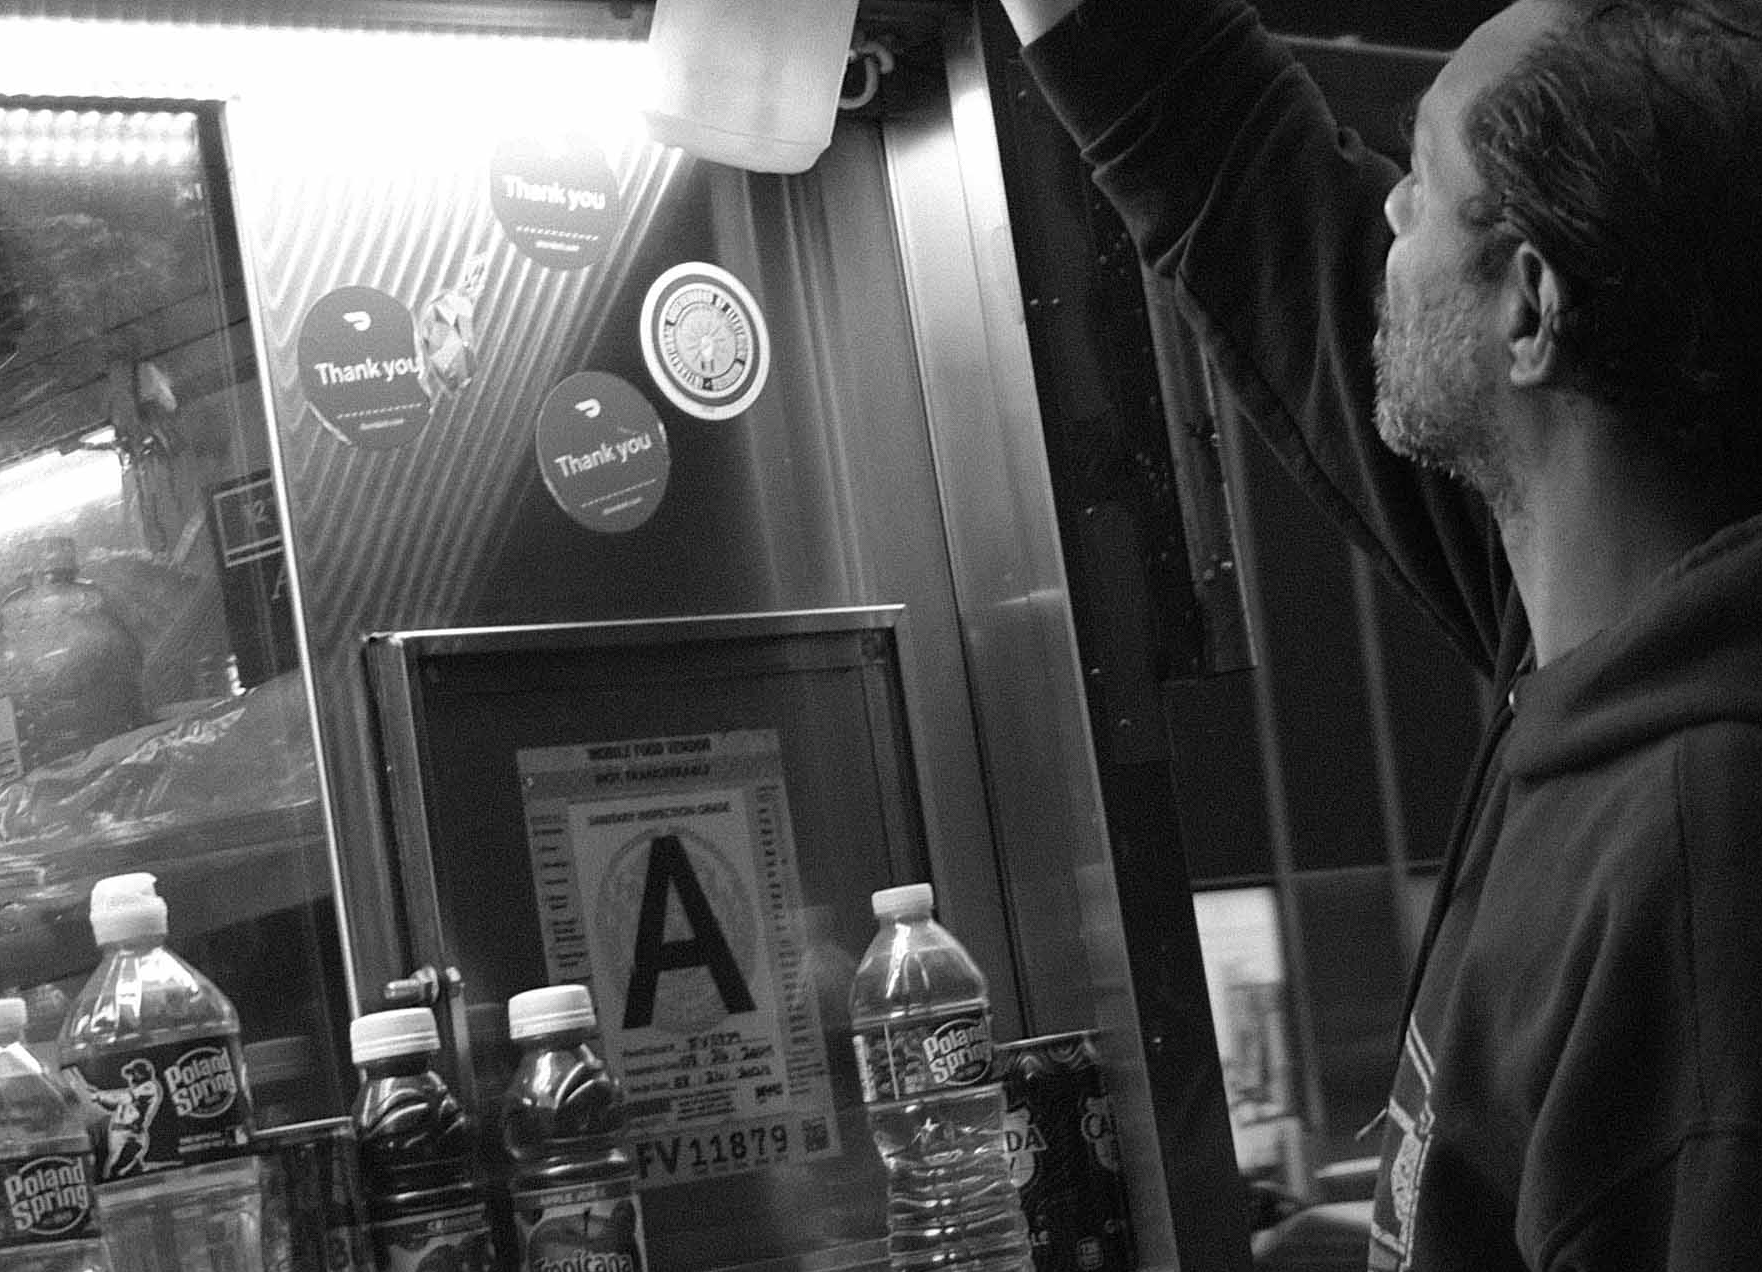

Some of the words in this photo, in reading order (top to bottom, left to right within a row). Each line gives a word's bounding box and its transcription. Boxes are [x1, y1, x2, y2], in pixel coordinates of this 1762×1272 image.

[503, 175, 566, 206] Thank
[567, 188, 606, 211] you
[314, 358, 381, 386] Thank
[382, 354, 425, 378] you
[555, 448, 615, 479] Thank
[615, 432, 653, 463] you
[622, 834, 756, 1029] A
[164, 1047, 231, 1094] Poland
[172, 1071, 237, 1116] Spring
[4, 1157, 86, 1206] Poland
[12, 1184, 88, 1230] Spring
